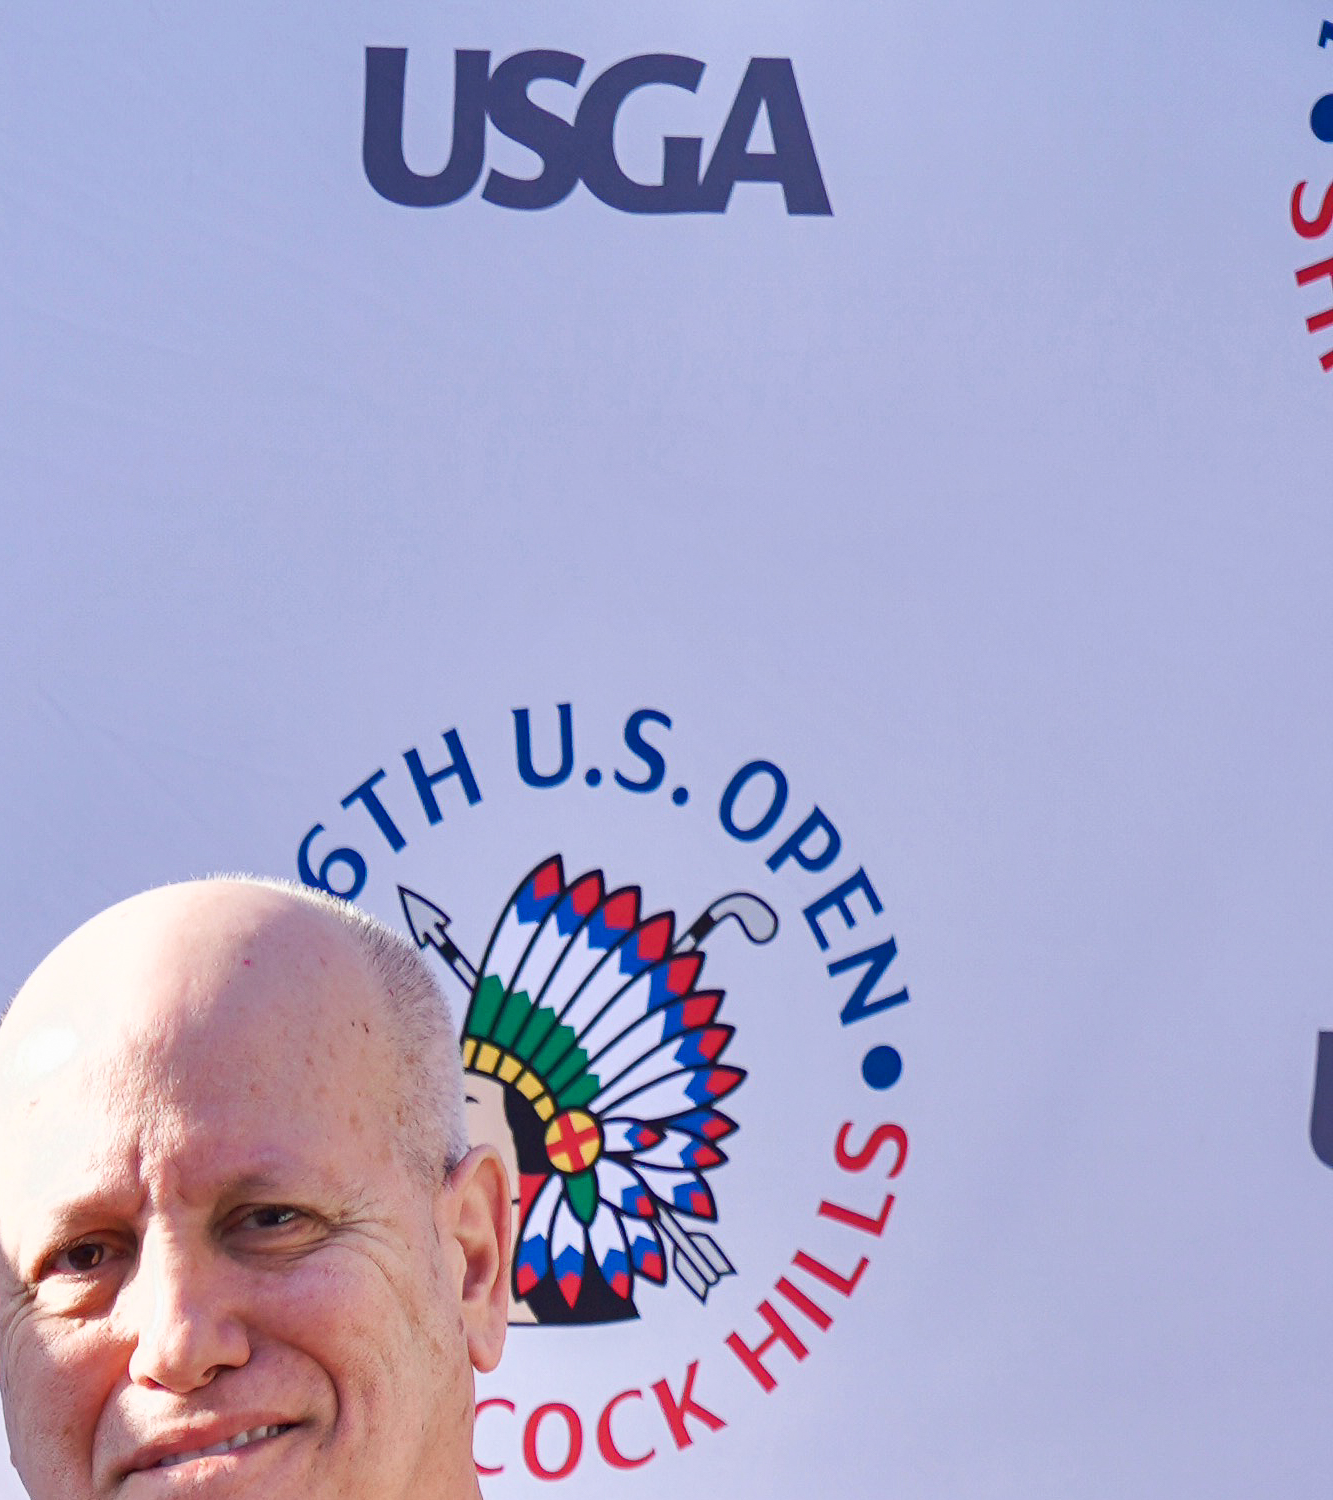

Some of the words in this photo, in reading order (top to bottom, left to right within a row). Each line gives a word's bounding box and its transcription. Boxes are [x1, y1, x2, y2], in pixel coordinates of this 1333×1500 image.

[362, 46, 833, 217] USGA
[297, 728, 483, 902] 6TH
[511, 703, 690, 806] U.S.
[718, 759, 910, 1026] OPEN
[724, 1120, 909, 1394] HILLS
